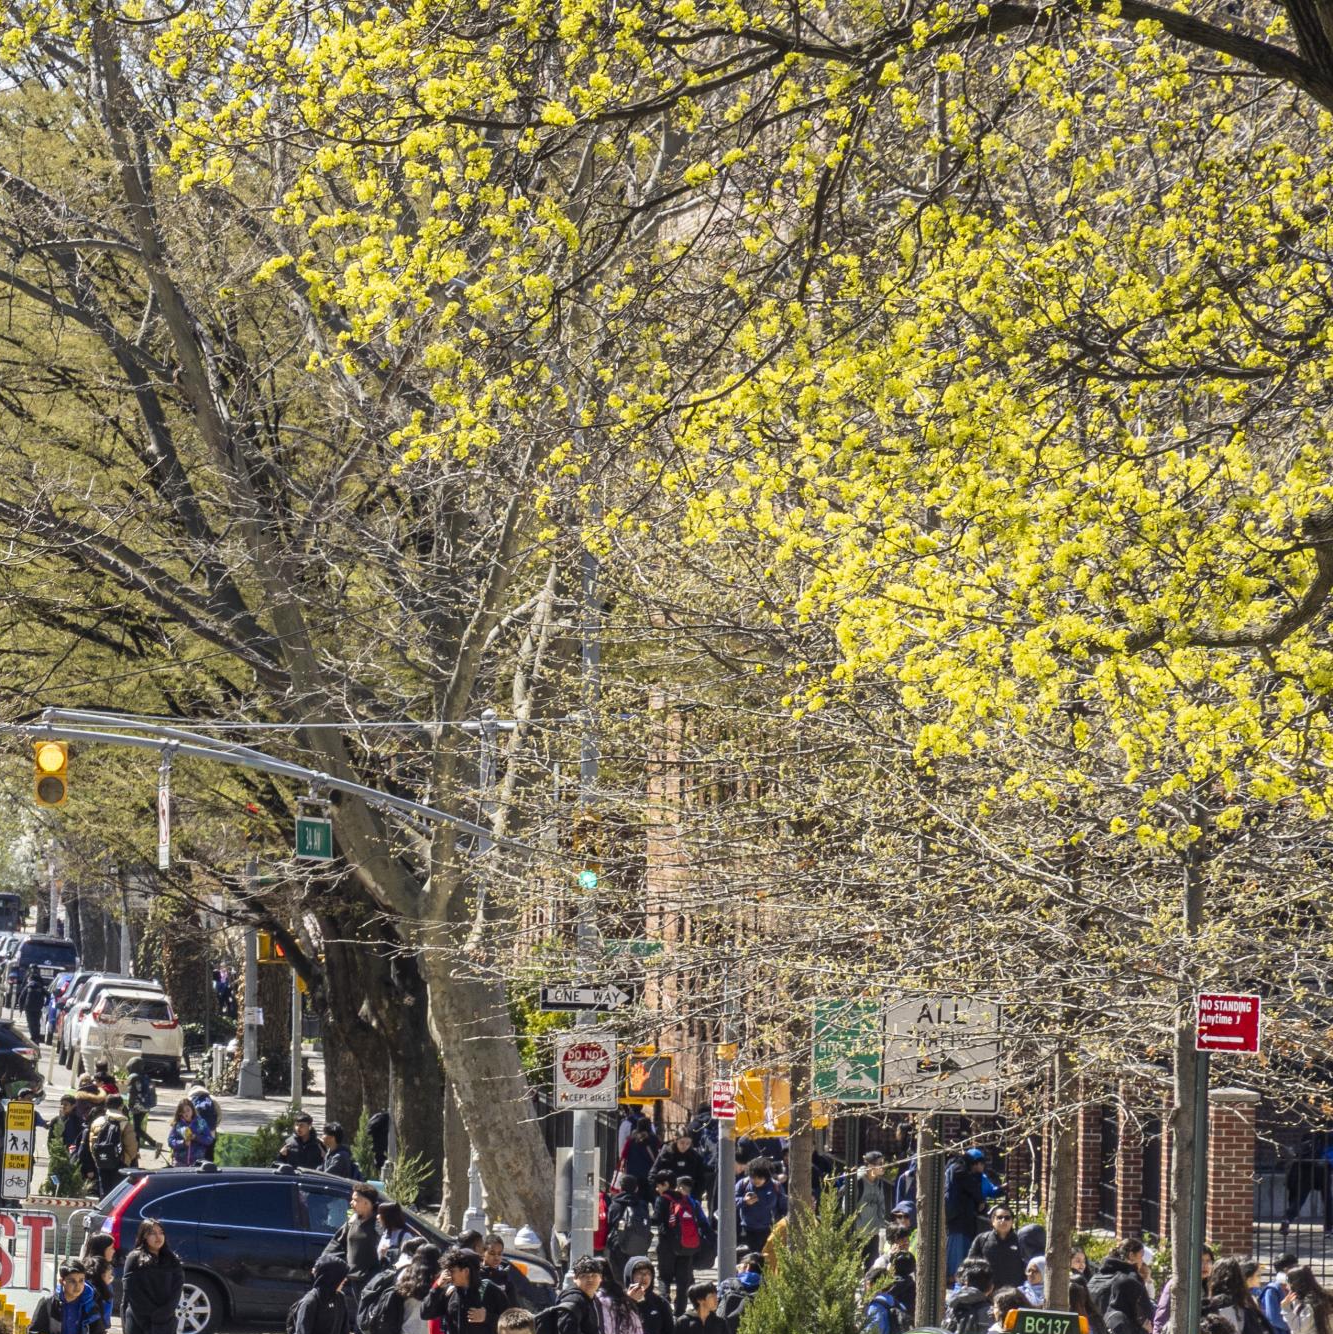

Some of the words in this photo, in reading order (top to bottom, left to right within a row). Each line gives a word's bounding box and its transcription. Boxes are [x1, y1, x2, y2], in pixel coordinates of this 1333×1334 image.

[554, 990, 581, 1002] ONE
[593, 991, 621, 1003] WAY
[1201, 999, 1213, 1010] NO
[1213, 1001, 1252, 1013] STANDING
[916, 1002, 967, 1025] ALL
[1201, 1012, 1233, 1026] Anytime
[568, 1050, 581, 1060] DO
[585, 1050, 604, 1060] NOT
[570, 1068, 602, 1080] ENTER
[8, 1161, 26, 1169] SLOW
